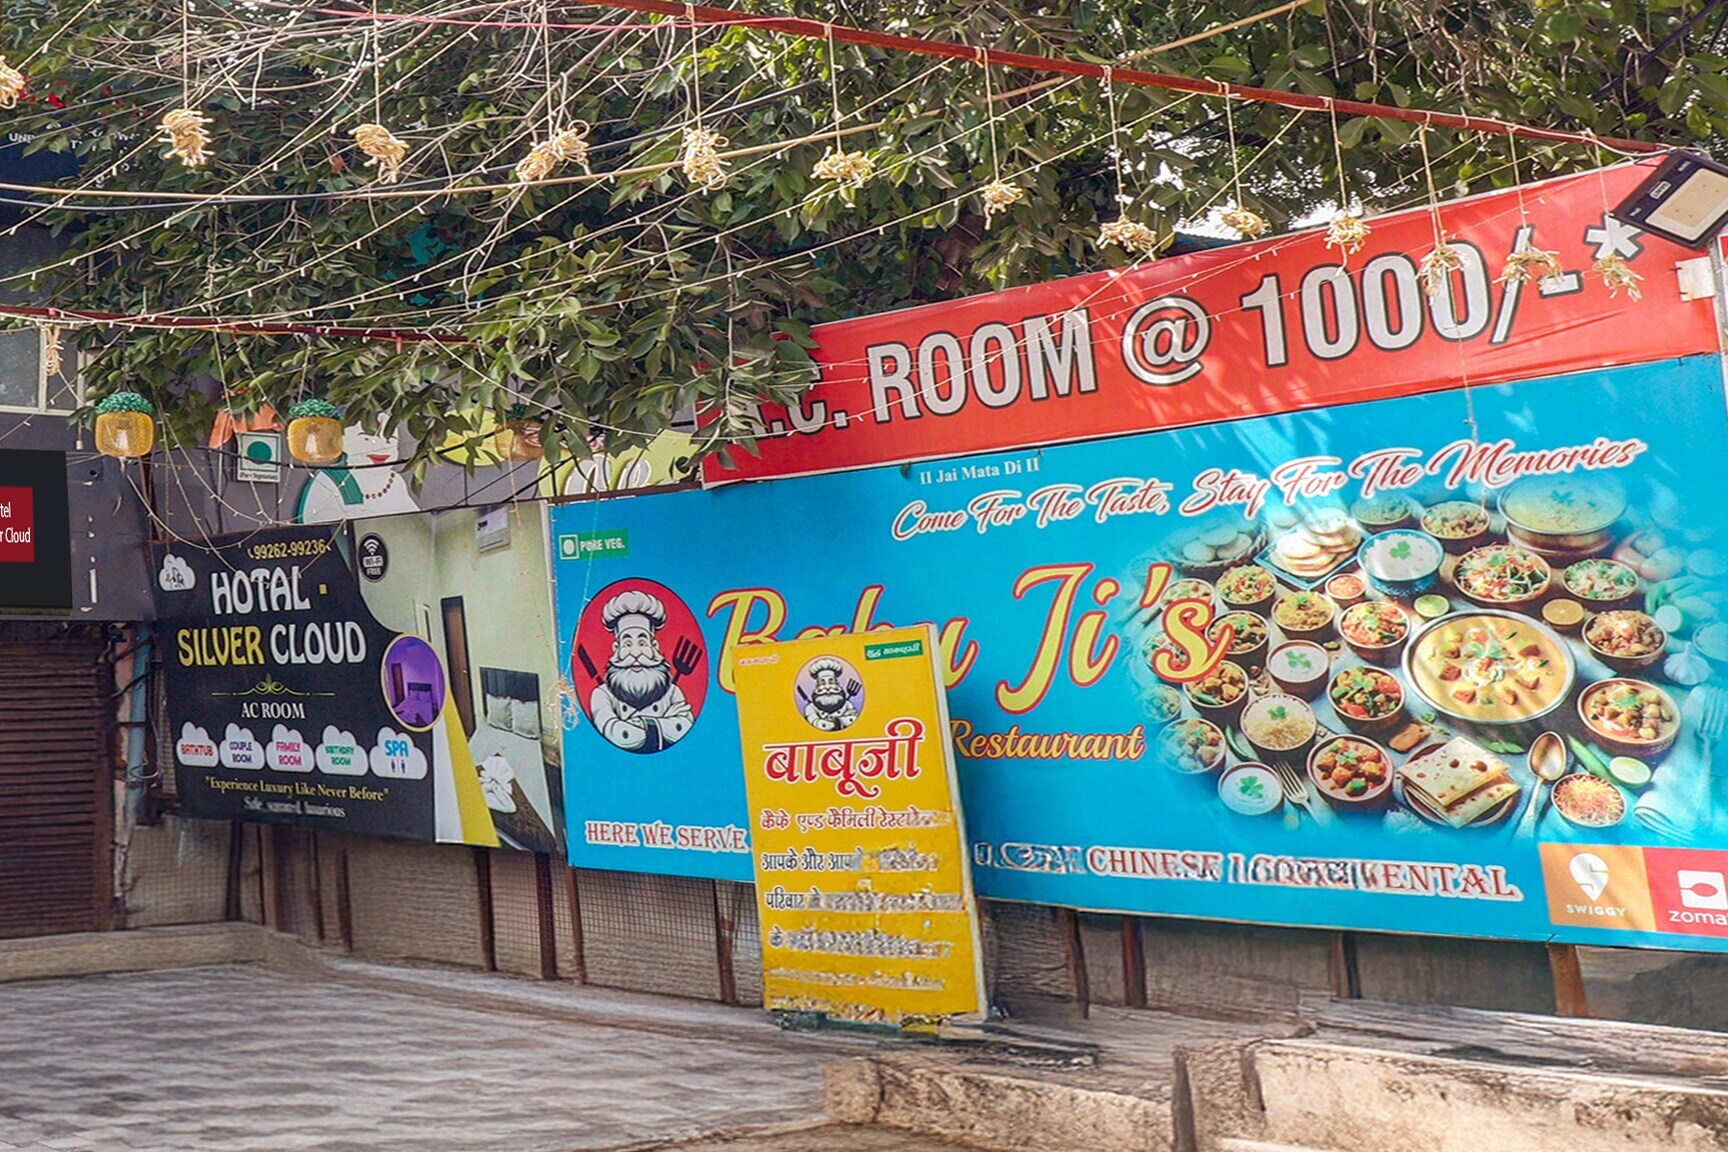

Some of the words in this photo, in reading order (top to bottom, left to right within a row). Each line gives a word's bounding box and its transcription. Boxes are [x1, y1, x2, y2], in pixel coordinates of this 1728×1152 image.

[867, 309, 1096, 426] ROOM
[1120, 294, 1211, 387] @
[936, 469, 958, 483] Jai
[962, 464, 1001, 481] Mata
[1004, 460, 1023, 475] Di
[892, 501, 967, 541] Come
[970, 491, 1027, 533] For
[1029, 484, 1084, 527] The
[1088, 477, 1174, 523] Taste,
[1180, 468, 1270, 519] Stay
[1272, 456, 1347, 505] For
[1351, 447, 1424, 499] The
[1427, 436, 1646, 489] Memories
[5, 525, 31, 545] Cloud
[580, 539, 603, 551] PURE
[254, 539, 326, 560] 99262-99236
[211, 566, 311, 615] HOTAL
[177, 625, 266, 666] SILVER
[272, 621, 367, 664] CLOUD
[241, 702, 259, 718] AC
[262, 702, 306, 719] ROOM
[385, 740, 409, 757] SPA
[951, 722, 1146, 761] Restaurant
[232, 754, 252, 763] ROOM
[278, 755, 302, 766] ROOM
[331, 756, 351, 765] ROOM
[763, 718, 925, 797] बाबूजी
[260, 780, 293, 798] Luxury
[295, 782, 315, 796] Like
[318, 785, 347, 799] Never
[586, 821, 639, 844] HERE
[641, 820, 673, 846] WE
[677, 824, 749, 851] SERVE
[1566, 904, 1626, 917] SWIGGY
[1668, 910, 1728, 926] zoma
